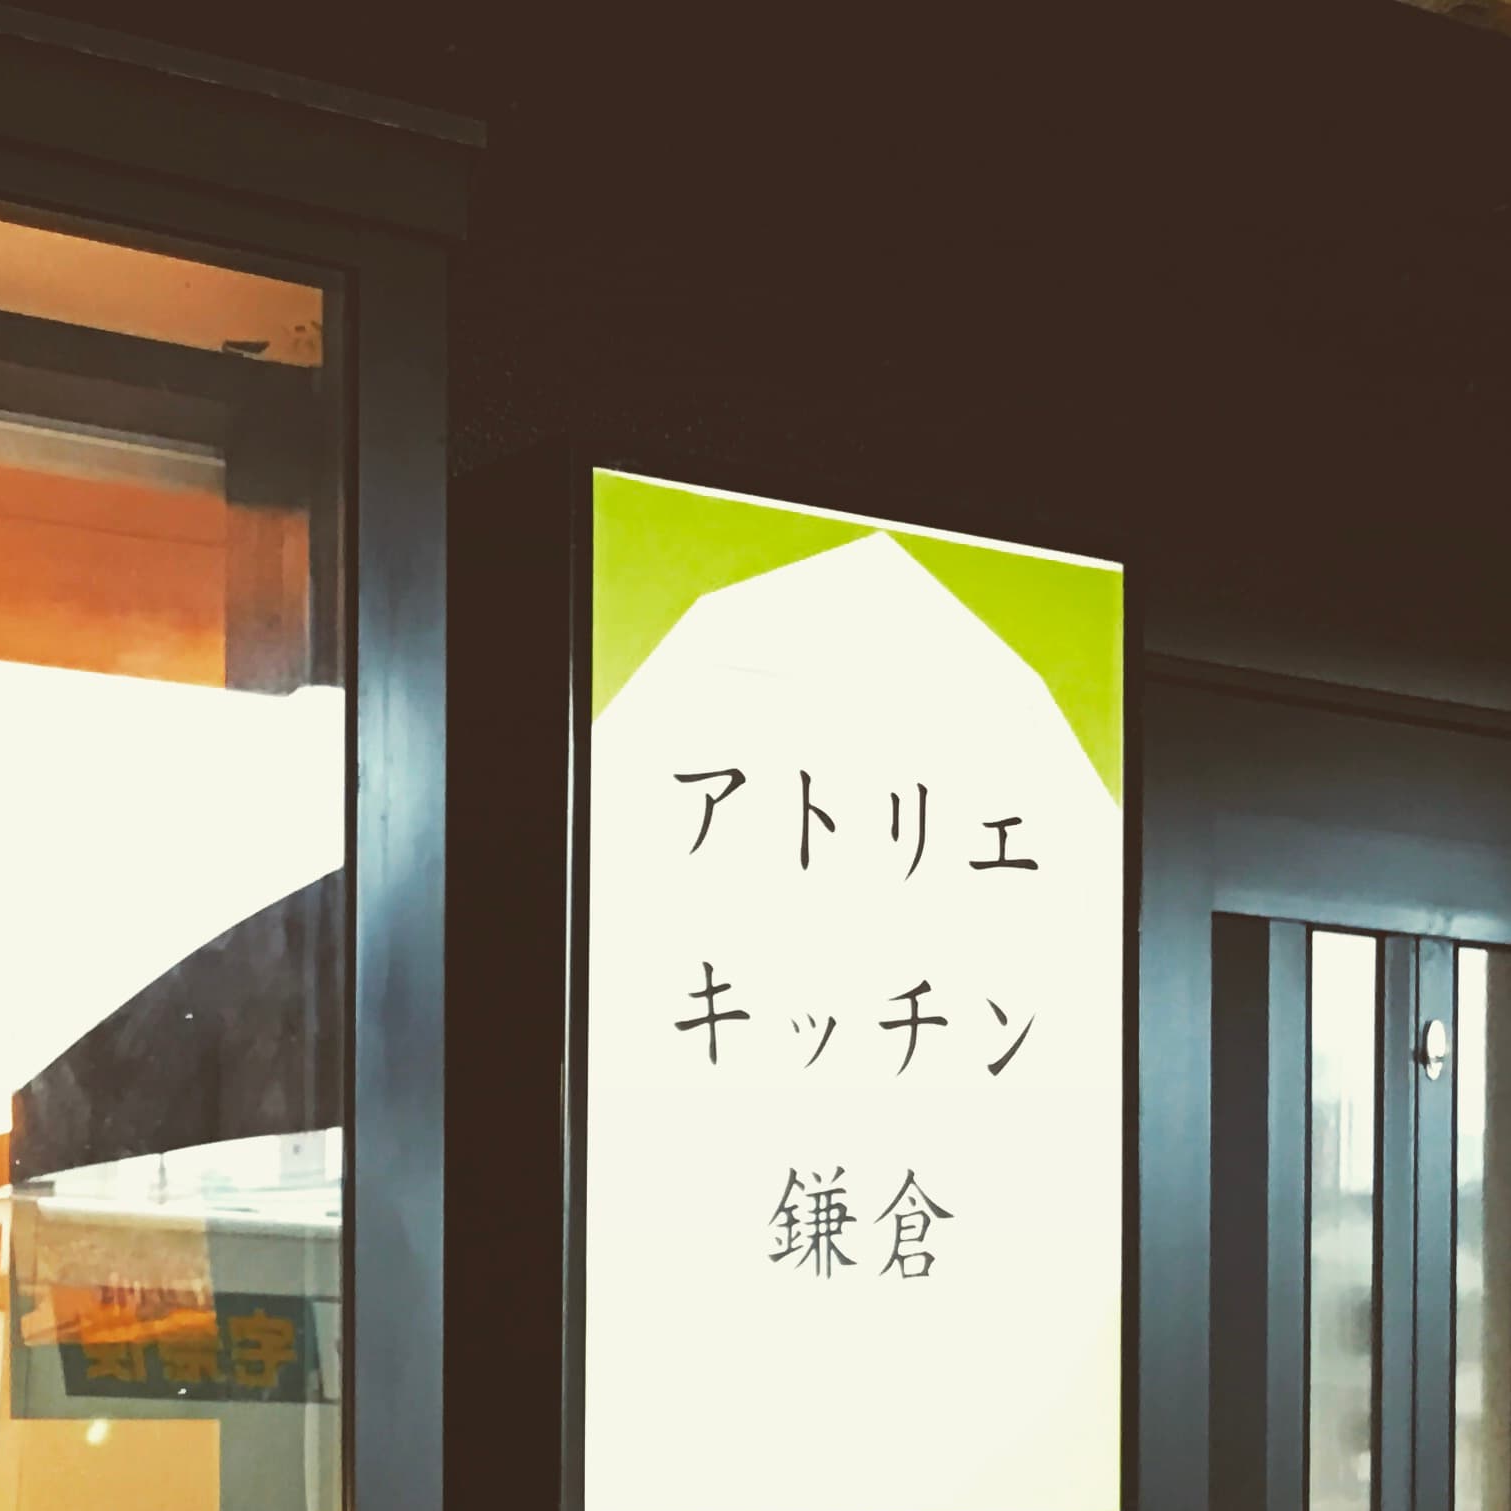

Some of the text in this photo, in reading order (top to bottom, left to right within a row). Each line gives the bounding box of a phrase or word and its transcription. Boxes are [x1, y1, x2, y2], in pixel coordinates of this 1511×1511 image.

[672, 767, 1040, 881] アトリエ
[673, 961, 1038, 1077] キッチン
[767, 1166, 956, 1280] 鎌倉
